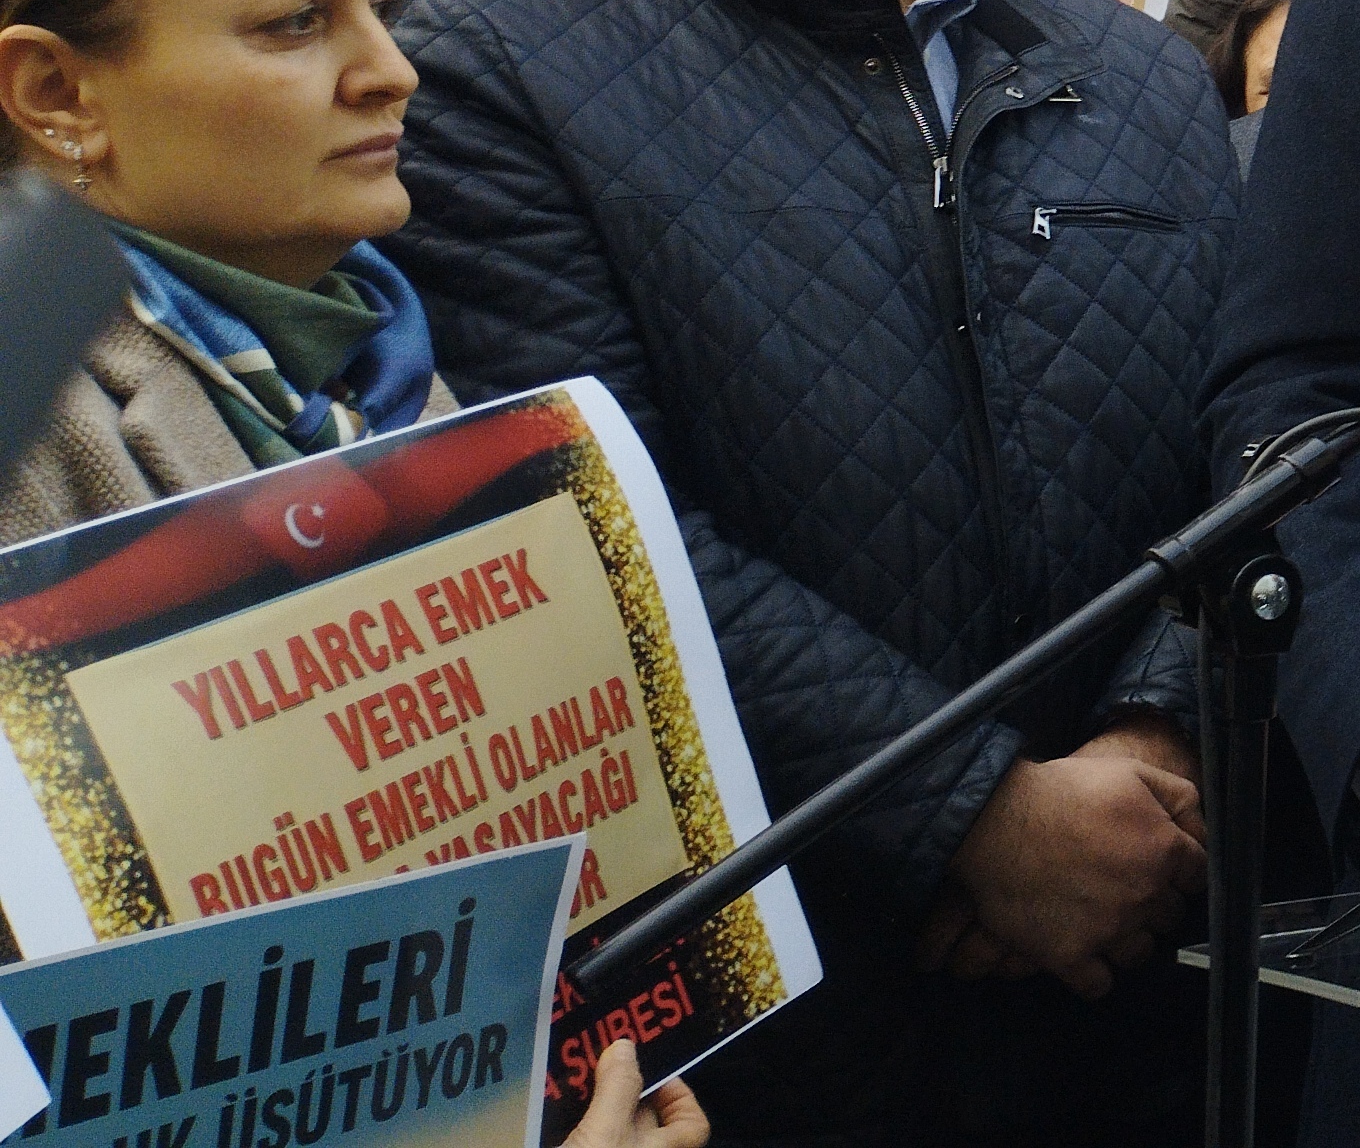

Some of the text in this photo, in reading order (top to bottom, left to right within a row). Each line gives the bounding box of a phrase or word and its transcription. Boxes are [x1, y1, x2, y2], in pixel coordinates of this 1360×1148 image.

[172, 547, 549, 741] YILLARCA EMEK
[325, 655, 486, 773] VEREN
[344, 733, 488, 864] EMEKLİ
[488, 675, 636, 793] OLANLAR
[424, 746, 639, 865] AYACAĞI
